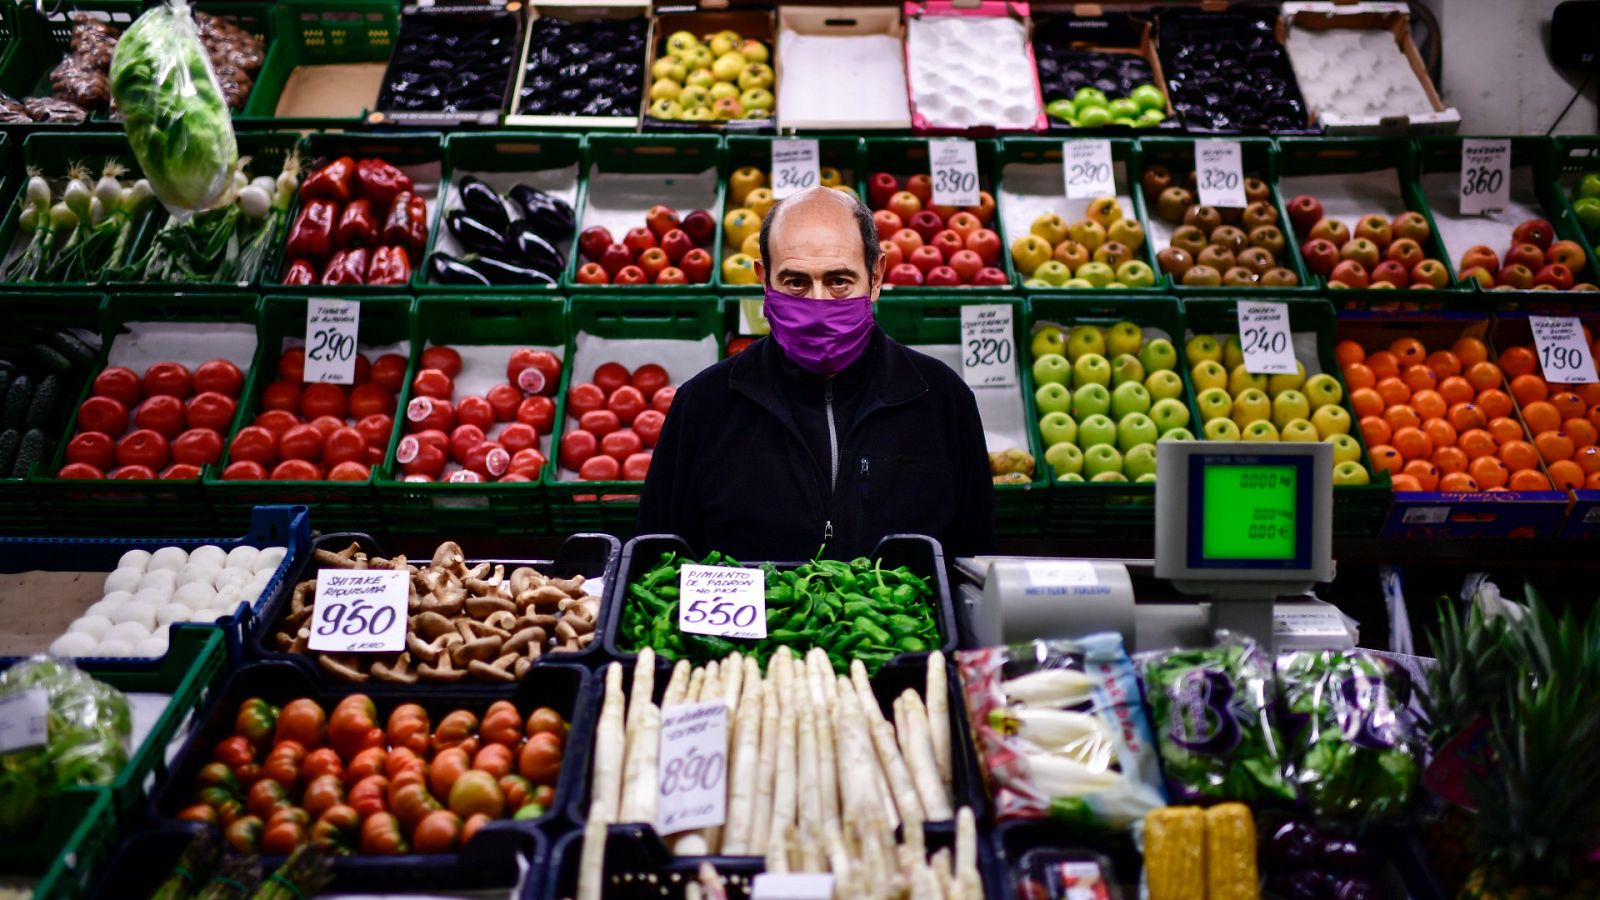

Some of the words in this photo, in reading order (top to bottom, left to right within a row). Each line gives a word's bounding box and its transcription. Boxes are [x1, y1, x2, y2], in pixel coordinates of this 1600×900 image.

[1463, 166, 1503, 196] 3'60
[308, 327, 355, 362] 2'90
[965, 337, 1011, 367] 3'20
[1244, 326, 1286, 355] 2'40
[1542, 342, 1583, 370] 1'90
[327, 576, 383, 586] SHITAKE
[687, 571, 751, 579] PIMIENTO
[706, 579, 755, 587] PADRON
[323, 584, 387, 598] RIQUISIMA
[317, 599, 396, 636] 9'50
[684, 596, 758, 628] 5'50
[659, 746, 724, 797] 8'90
